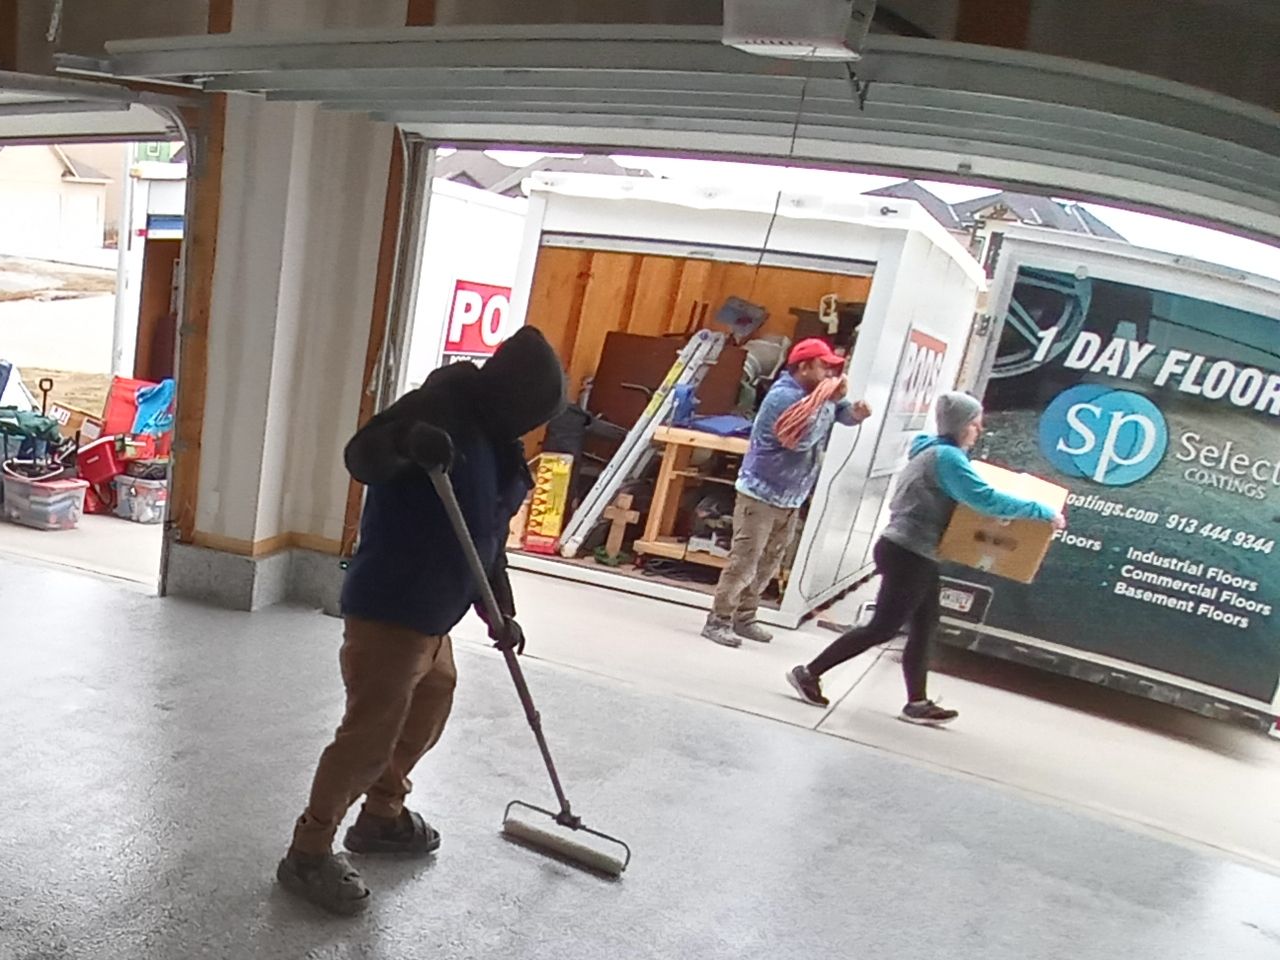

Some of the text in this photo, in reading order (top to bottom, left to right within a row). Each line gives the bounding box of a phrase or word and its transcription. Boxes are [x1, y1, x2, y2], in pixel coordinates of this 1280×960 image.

[1033, 326, 1059, 362] 1
[1063, 331, 1156, 380] DAY
[1184, 467, 1268, 500] COATINGS
[1051, 529, 1103, 551] Floors
[1165, 513, 1198, 534] 913
[1199, 522, 1237, 543] 444
[1232, 530, 1275, 555] 9344
[1120, 564, 1273, 617] Commercial Floors
[1126, 546, 1259, 593] Industrial Floors
[1113, 581, 1249, 629] Basement Floors
